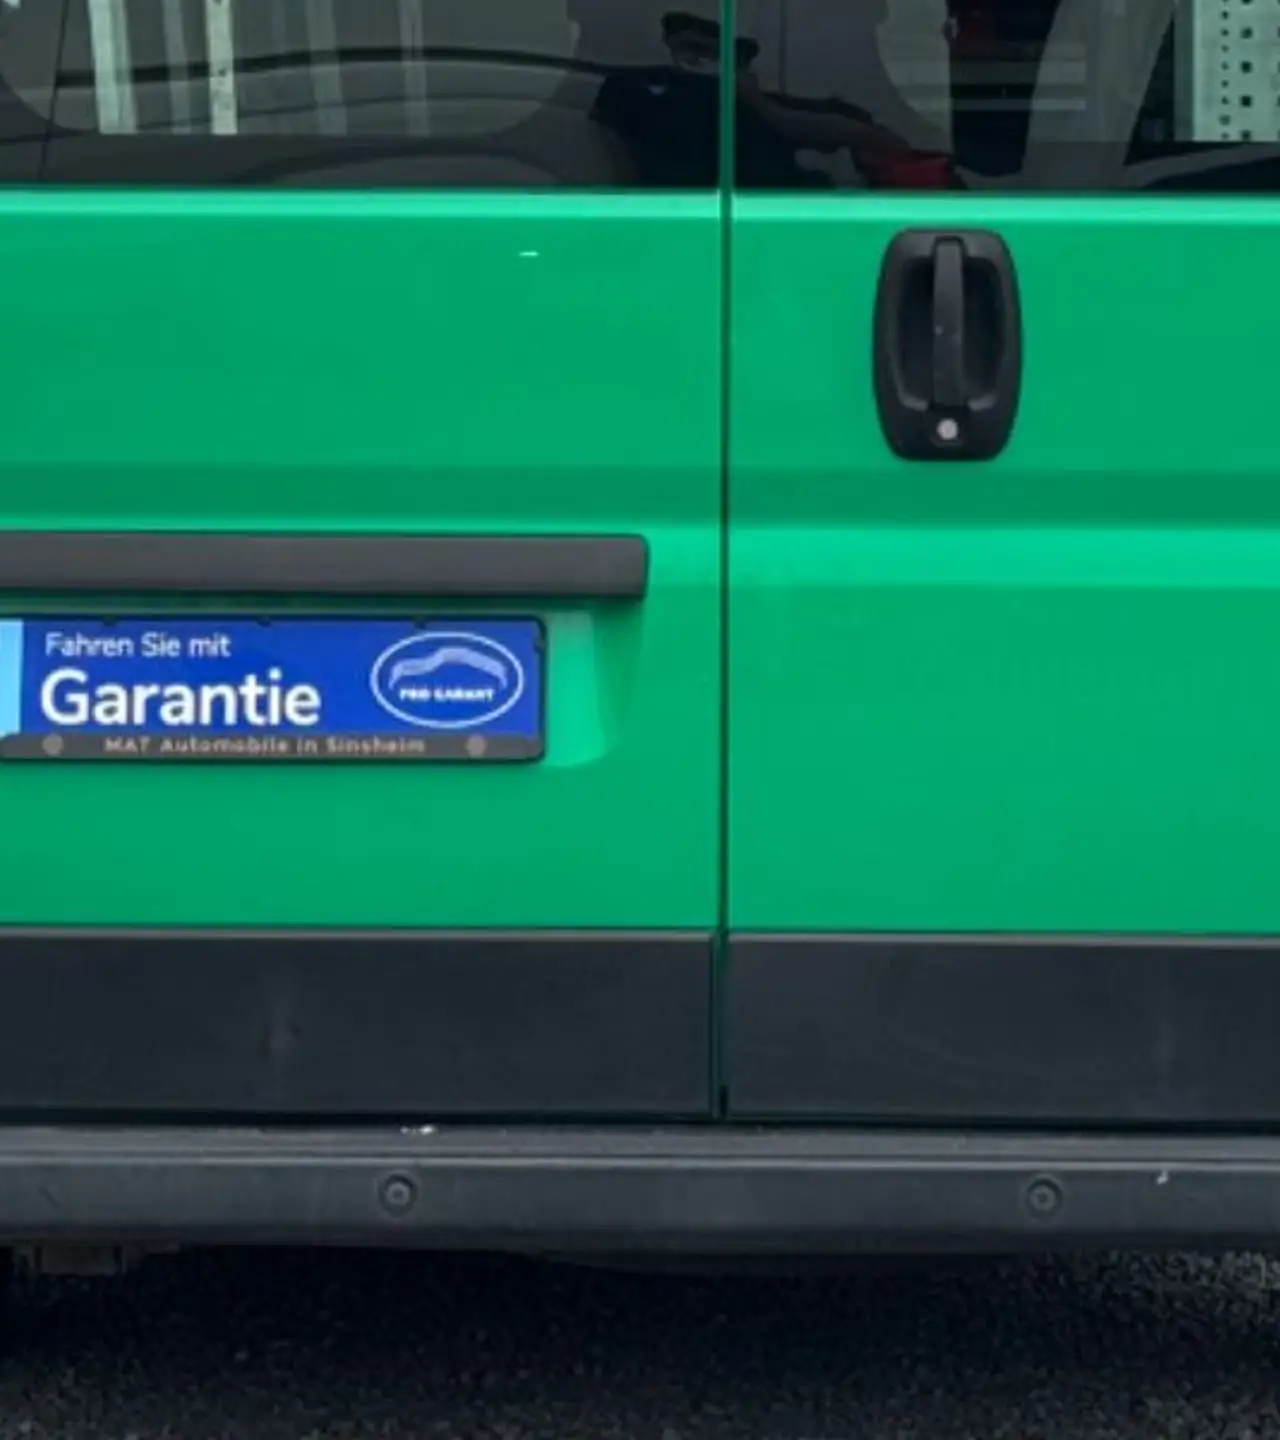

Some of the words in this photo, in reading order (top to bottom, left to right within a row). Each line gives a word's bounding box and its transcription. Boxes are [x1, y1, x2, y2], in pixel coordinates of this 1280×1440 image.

[45, 632, 133, 657] Fahren
[141, 631, 181, 658] Sie
[188, 632, 231, 658] mit
[40, 666, 321, 726] Garantie
[104, 735, 151, 754] MAT
[160, 735, 287, 754] Automobile
[297, 735, 318, 754] in
[326, 734, 427, 754] Sinsheim
